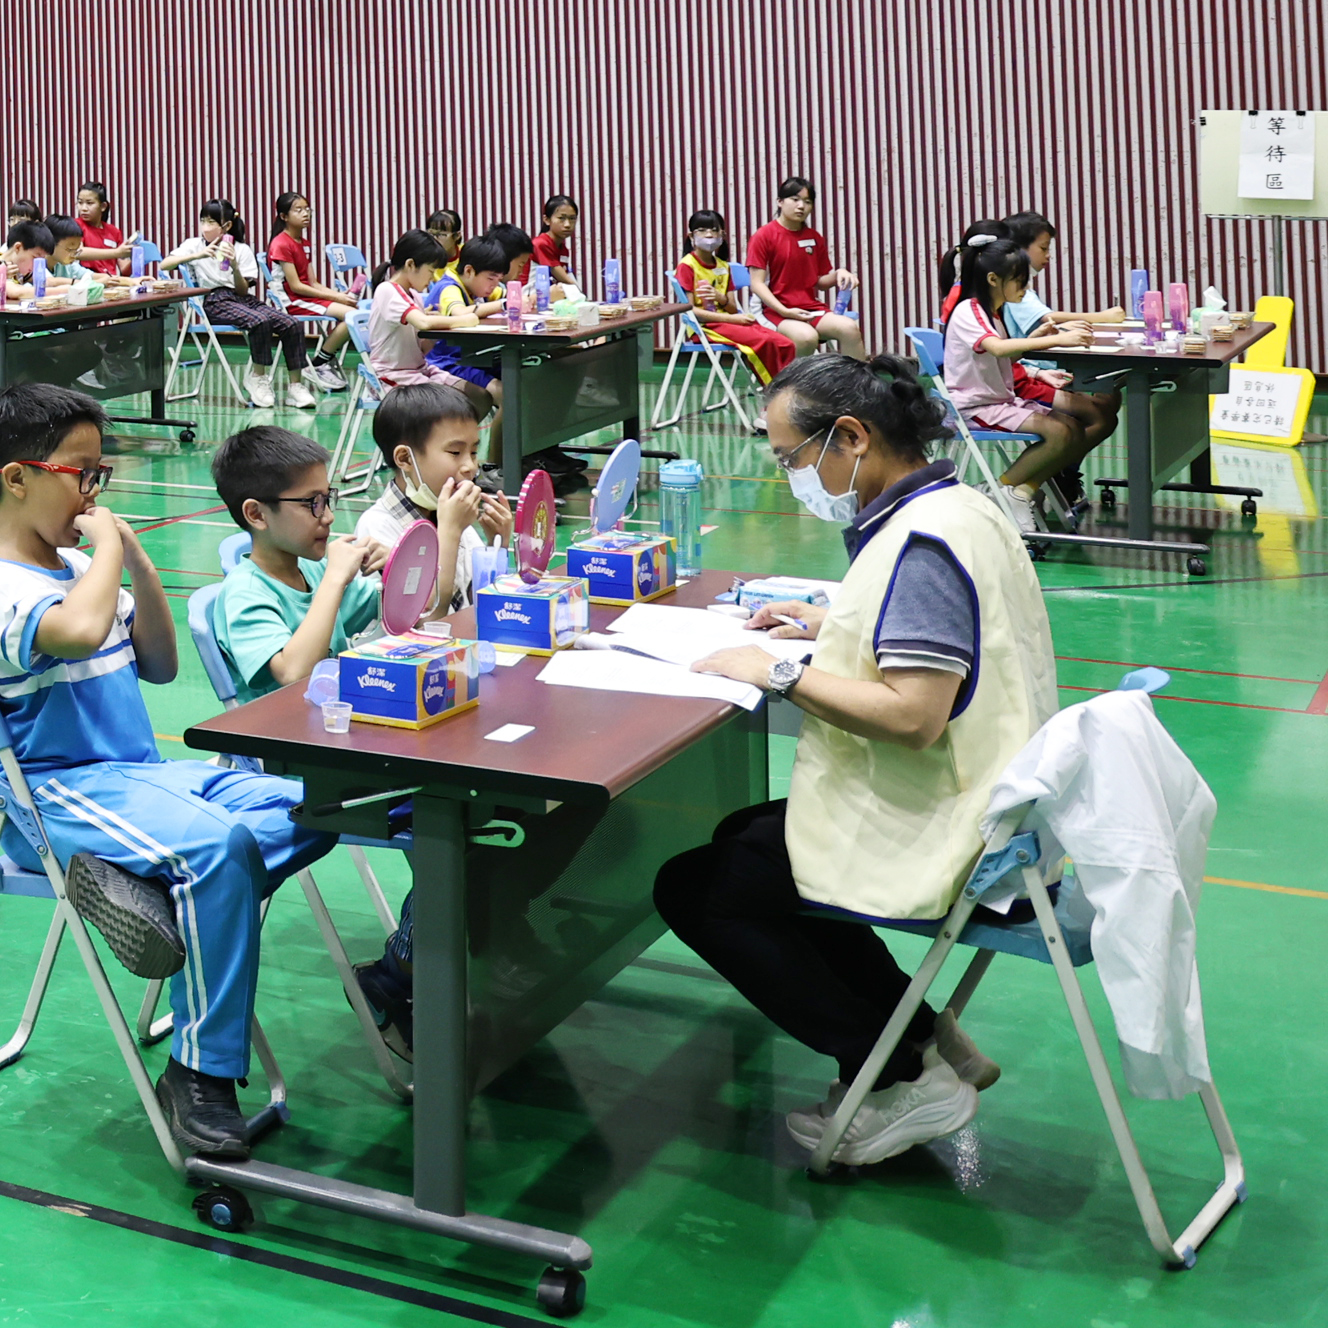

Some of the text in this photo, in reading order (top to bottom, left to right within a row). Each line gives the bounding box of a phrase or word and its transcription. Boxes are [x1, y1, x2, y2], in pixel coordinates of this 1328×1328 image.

[1265, 116, 1287, 190] 等待區
[1236, 396, 1277, 410] 返回各自
[582, 562, 617, 579] Kleenex
[494, 608, 532, 625] Kleenex
[367, 665, 387, 678] 舒潔
[356, 675, 398, 693] Kleenex
[423, 684, 445, 703] Kleenex
[877, 1087, 927, 1126] HOKA
